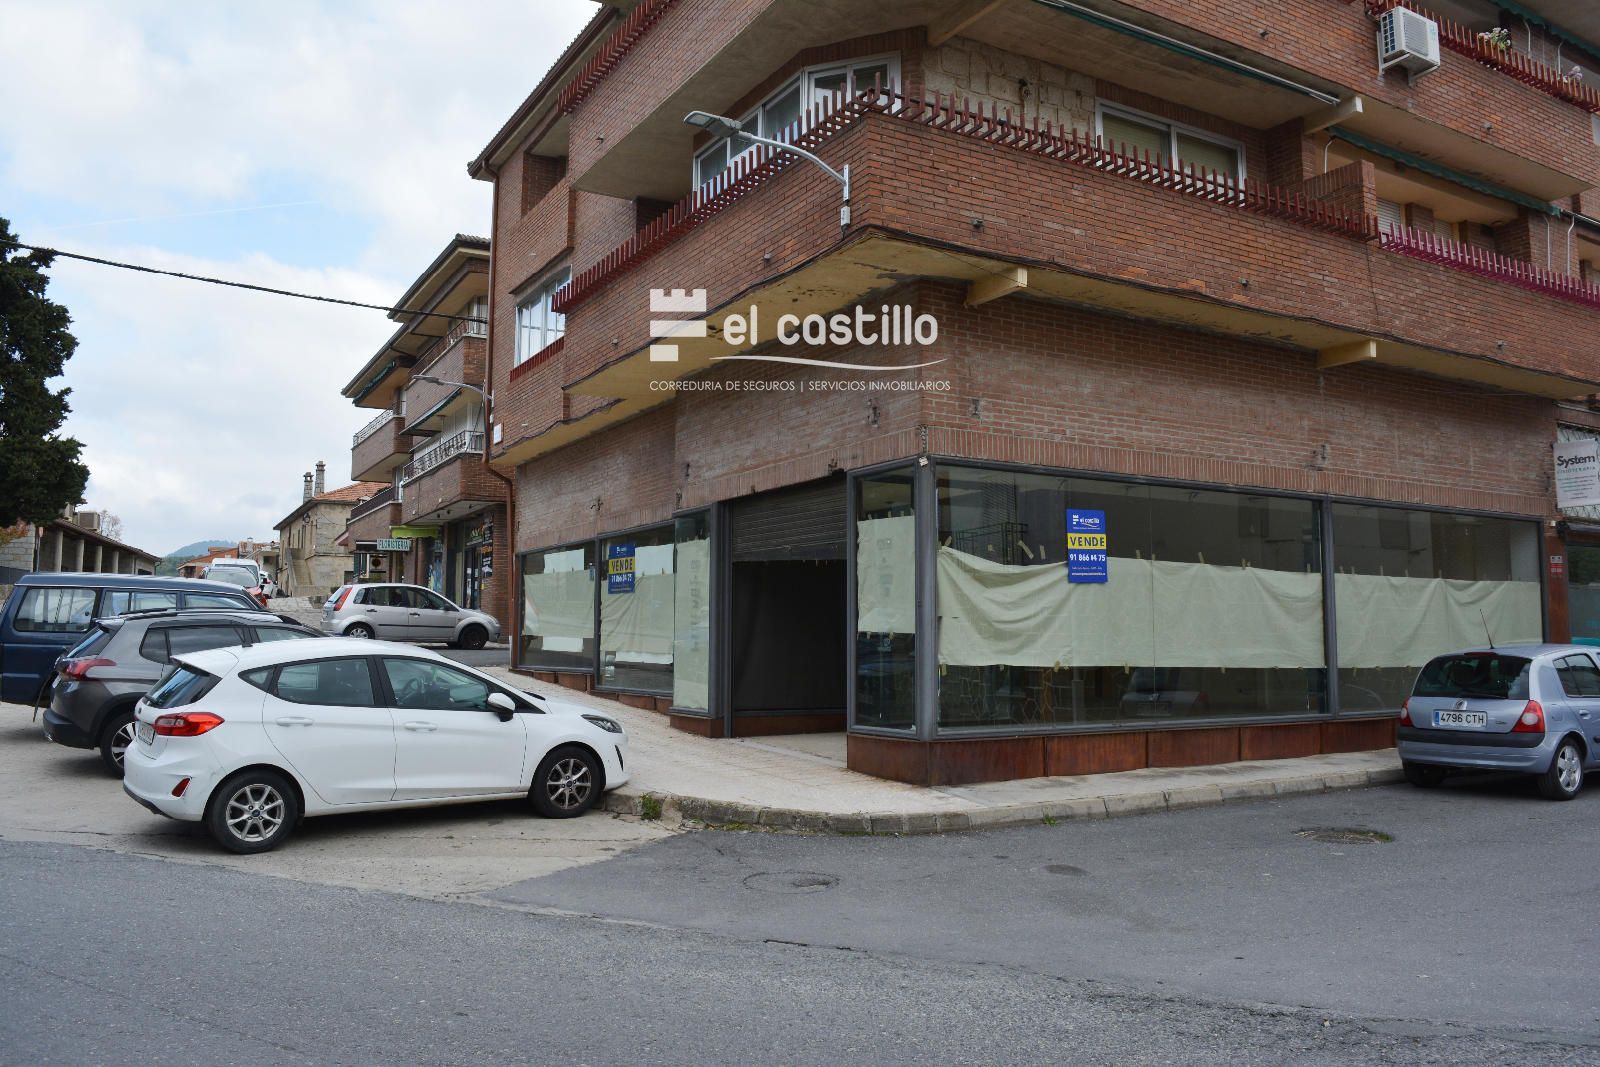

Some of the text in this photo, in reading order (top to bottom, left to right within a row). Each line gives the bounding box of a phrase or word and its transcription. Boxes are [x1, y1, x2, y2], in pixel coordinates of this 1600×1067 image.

[1557, 455, 1595, 468] System
[378, 540, 408, 549] FLORISTERIA
[1069, 536, 1105, 547] VENDE
[1069, 553, 1077, 561] 91
[1098, 554, 1106, 562] 75
[611, 558, 633, 572] VENDE
[1441, 713, 1463, 723] 4796
[1465, 714, 1484, 724] CTH
